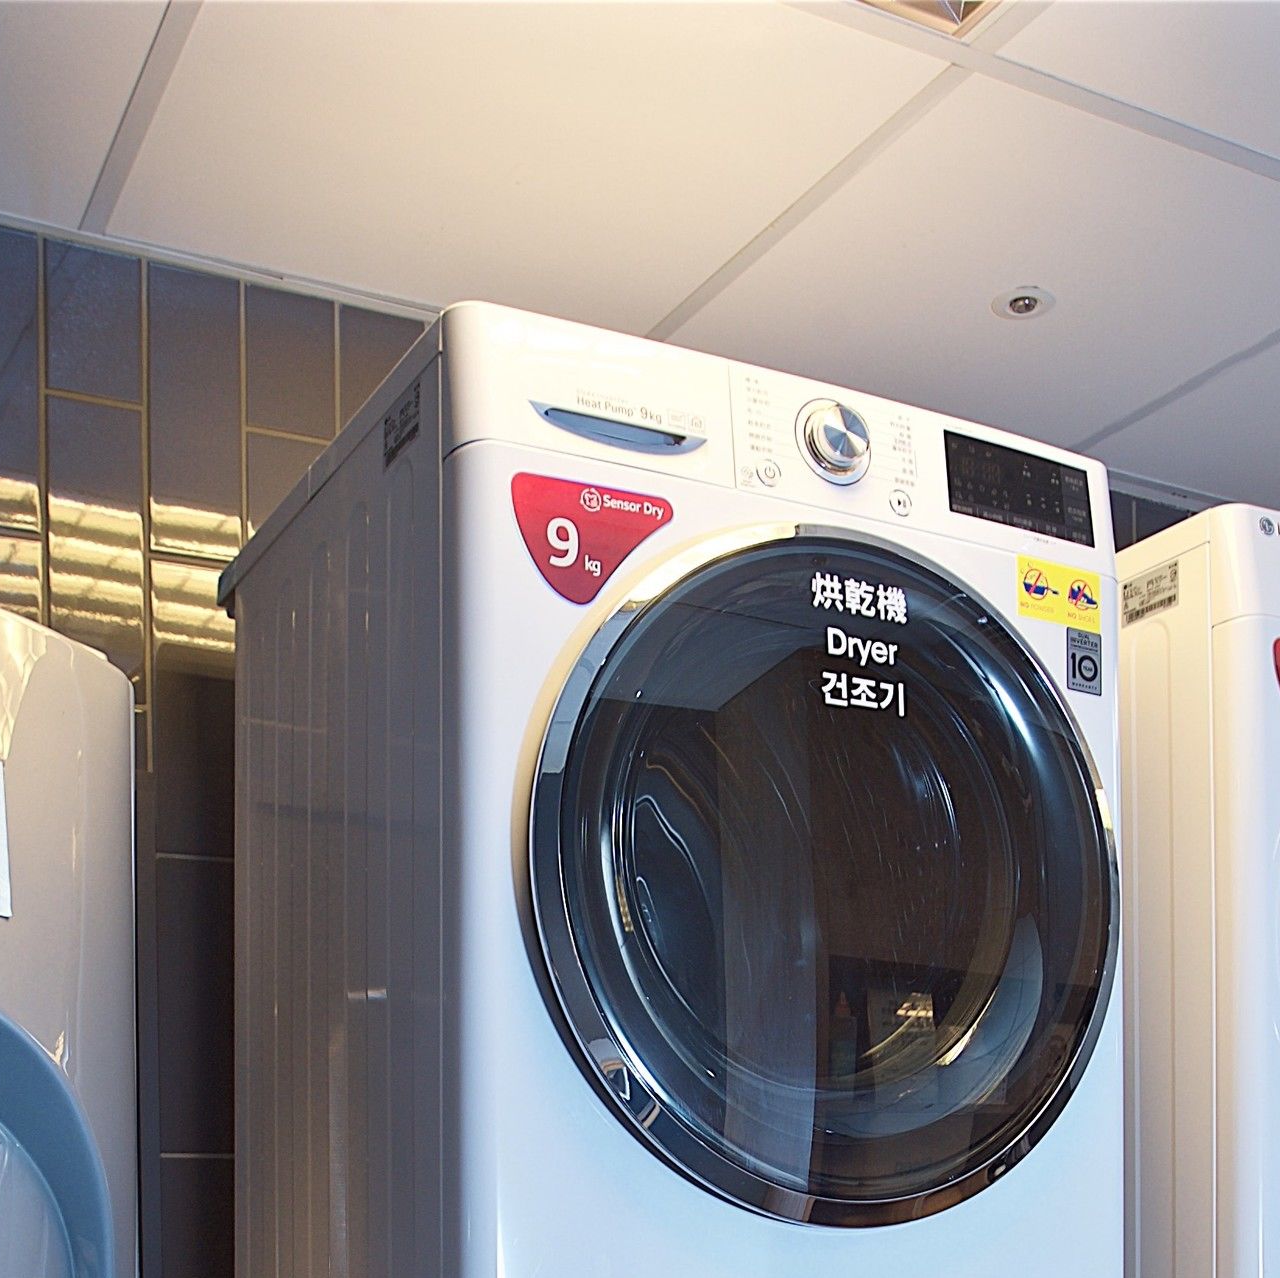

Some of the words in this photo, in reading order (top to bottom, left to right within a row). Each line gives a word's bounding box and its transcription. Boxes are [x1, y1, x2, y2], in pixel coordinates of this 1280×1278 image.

[603, 494, 641, 513] Sensor
[643, 500, 665, 519] Dry
[545, 516, 580, 568] 9
[584, 555, 602, 577] kg
[812, 572, 908, 626] 烘乾機
[827, 627, 898, 667] Dryer
[1071, 652, 1098, 682] 10
[821, 672, 906, 717] 건조기
